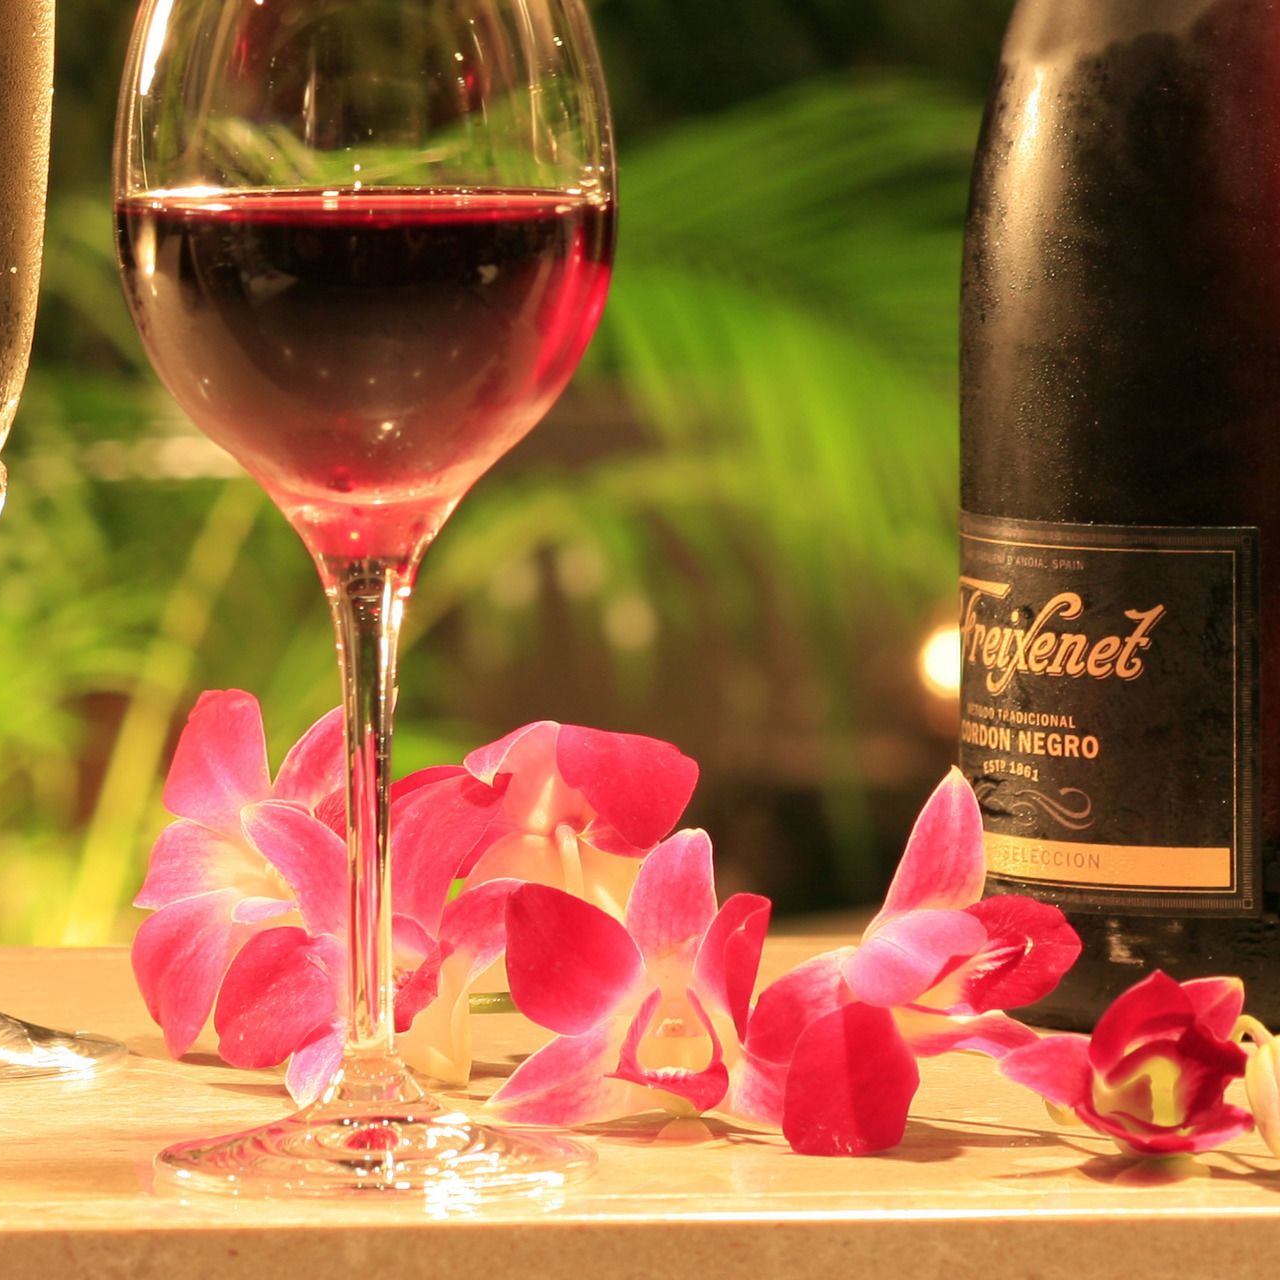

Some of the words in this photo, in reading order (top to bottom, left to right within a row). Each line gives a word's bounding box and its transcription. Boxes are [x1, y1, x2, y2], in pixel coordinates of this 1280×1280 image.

[1052, 559, 1085, 571] SPAIN
[959, 576, 1167, 697] Freixenet
[997, 708, 1076, 729] TRADICIONAL
[1018, 730, 1099, 759] NEGRO
[1009, 761, 1040, 782] 1861
[1002, 845, 1100, 869] SELECCION
